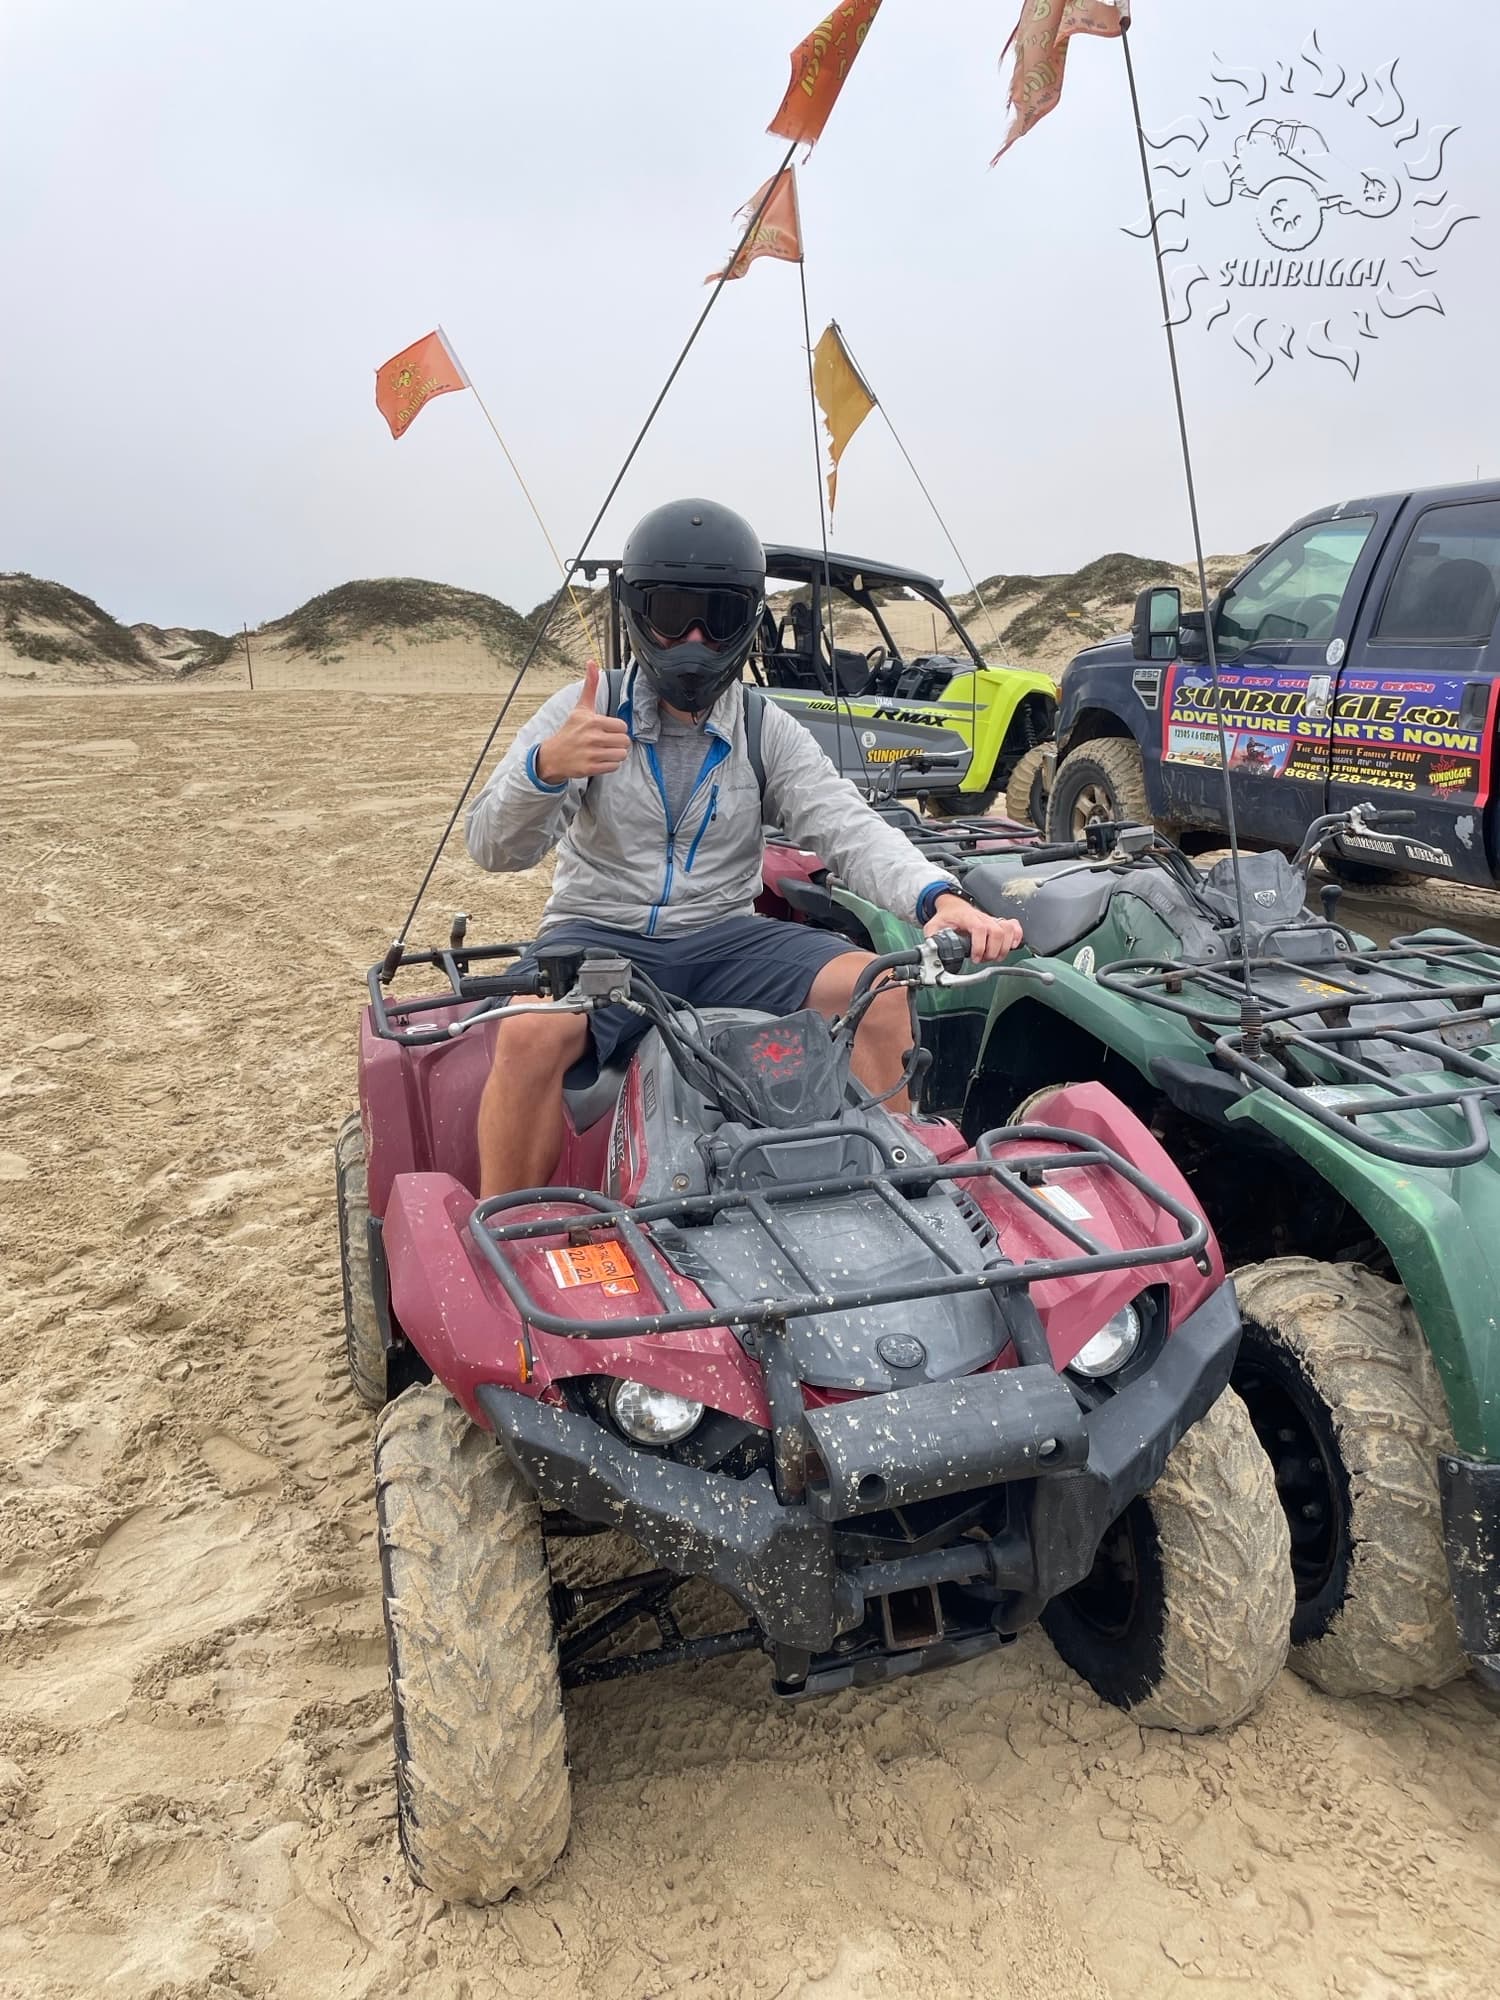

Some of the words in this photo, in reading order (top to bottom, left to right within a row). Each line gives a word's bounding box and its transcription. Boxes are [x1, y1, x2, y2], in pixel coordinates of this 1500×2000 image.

[807, 702, 838, 711] 1000
[872, 707, 949, 727] RMAX
[1170, 709, 1291, 733] ADVENTURE
[1296, 721, 1396, 741] STARTS
[1403, 728, 1478, 752] NOW!
[1390, 751, 1421, 763] FUN!
[1284, 767, 1417, 791] 866-728-4443
[1293, 761, 1321, 771] WHERE
[1342, 765, 1359, 774] FUN
[1360, 766, 1388, 778] NEVER
[1389, 771, 1414, 780] SETS!
[1429, 767, 1472, 784] SUNBUGGIE
